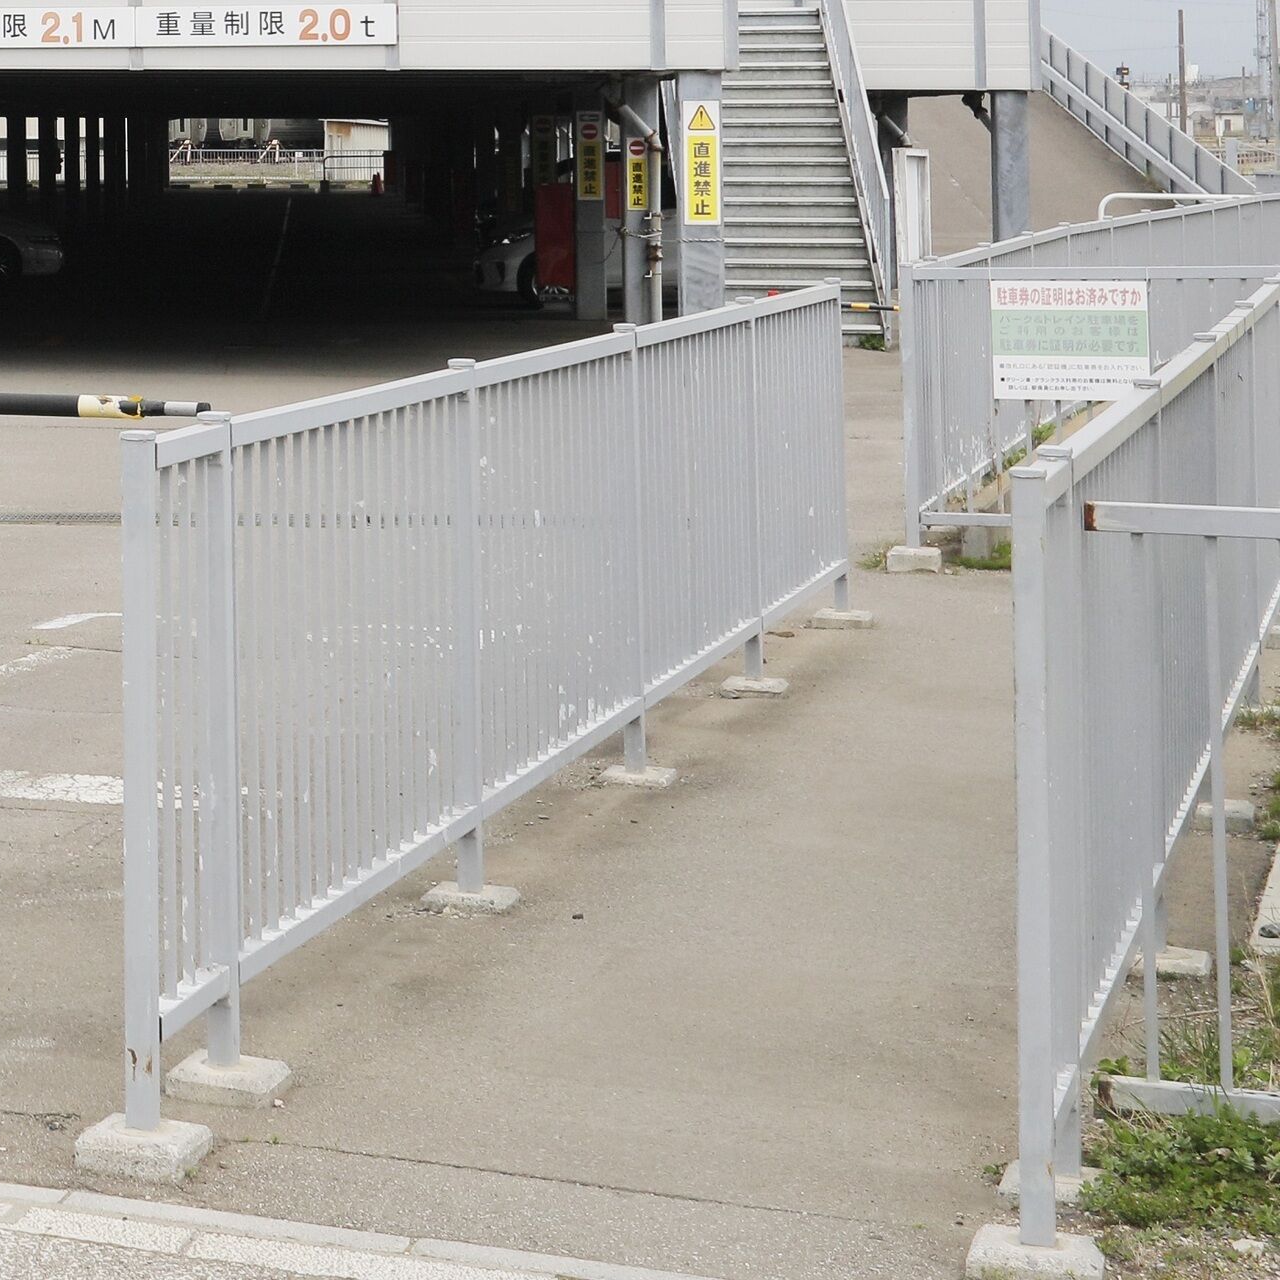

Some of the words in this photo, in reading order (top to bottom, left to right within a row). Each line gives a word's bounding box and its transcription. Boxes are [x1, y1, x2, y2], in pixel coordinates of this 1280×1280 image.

[632, 162, 644, 206] 直進禁止
[693, 141, 712, 216] 直進禁止
[996, 287, 1142, 306] 駐車券の証明はお済みですか
